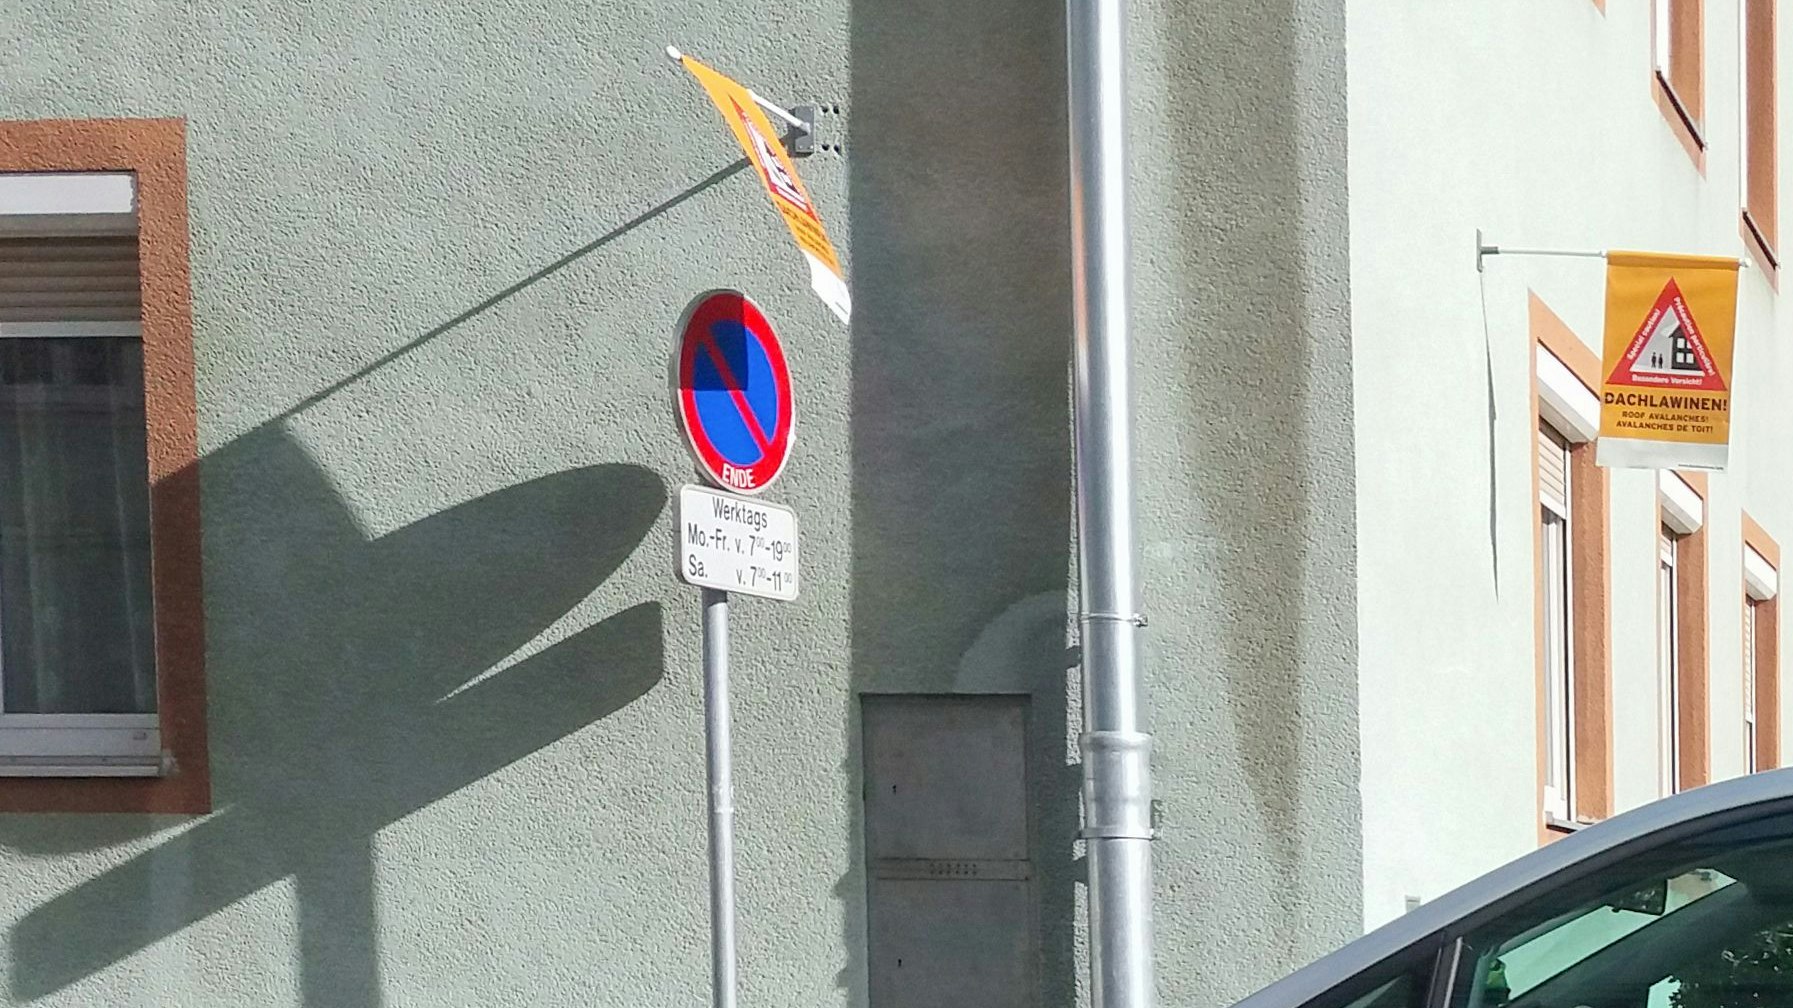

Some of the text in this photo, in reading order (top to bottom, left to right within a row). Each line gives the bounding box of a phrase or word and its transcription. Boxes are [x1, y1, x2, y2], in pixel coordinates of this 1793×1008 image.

[1604, 392, 1727, 411] DACHLAWINEN!
[1616, 420, 1713, 434] AVALANCHES DE TOIT!
[1622, 411, 1709, 423] ROOF AVALANCHES!
[722, 463, 756, 488] ENDE
[712, 496, 768, 532] Werktags
[688, 554, 708, 578] Sa.
